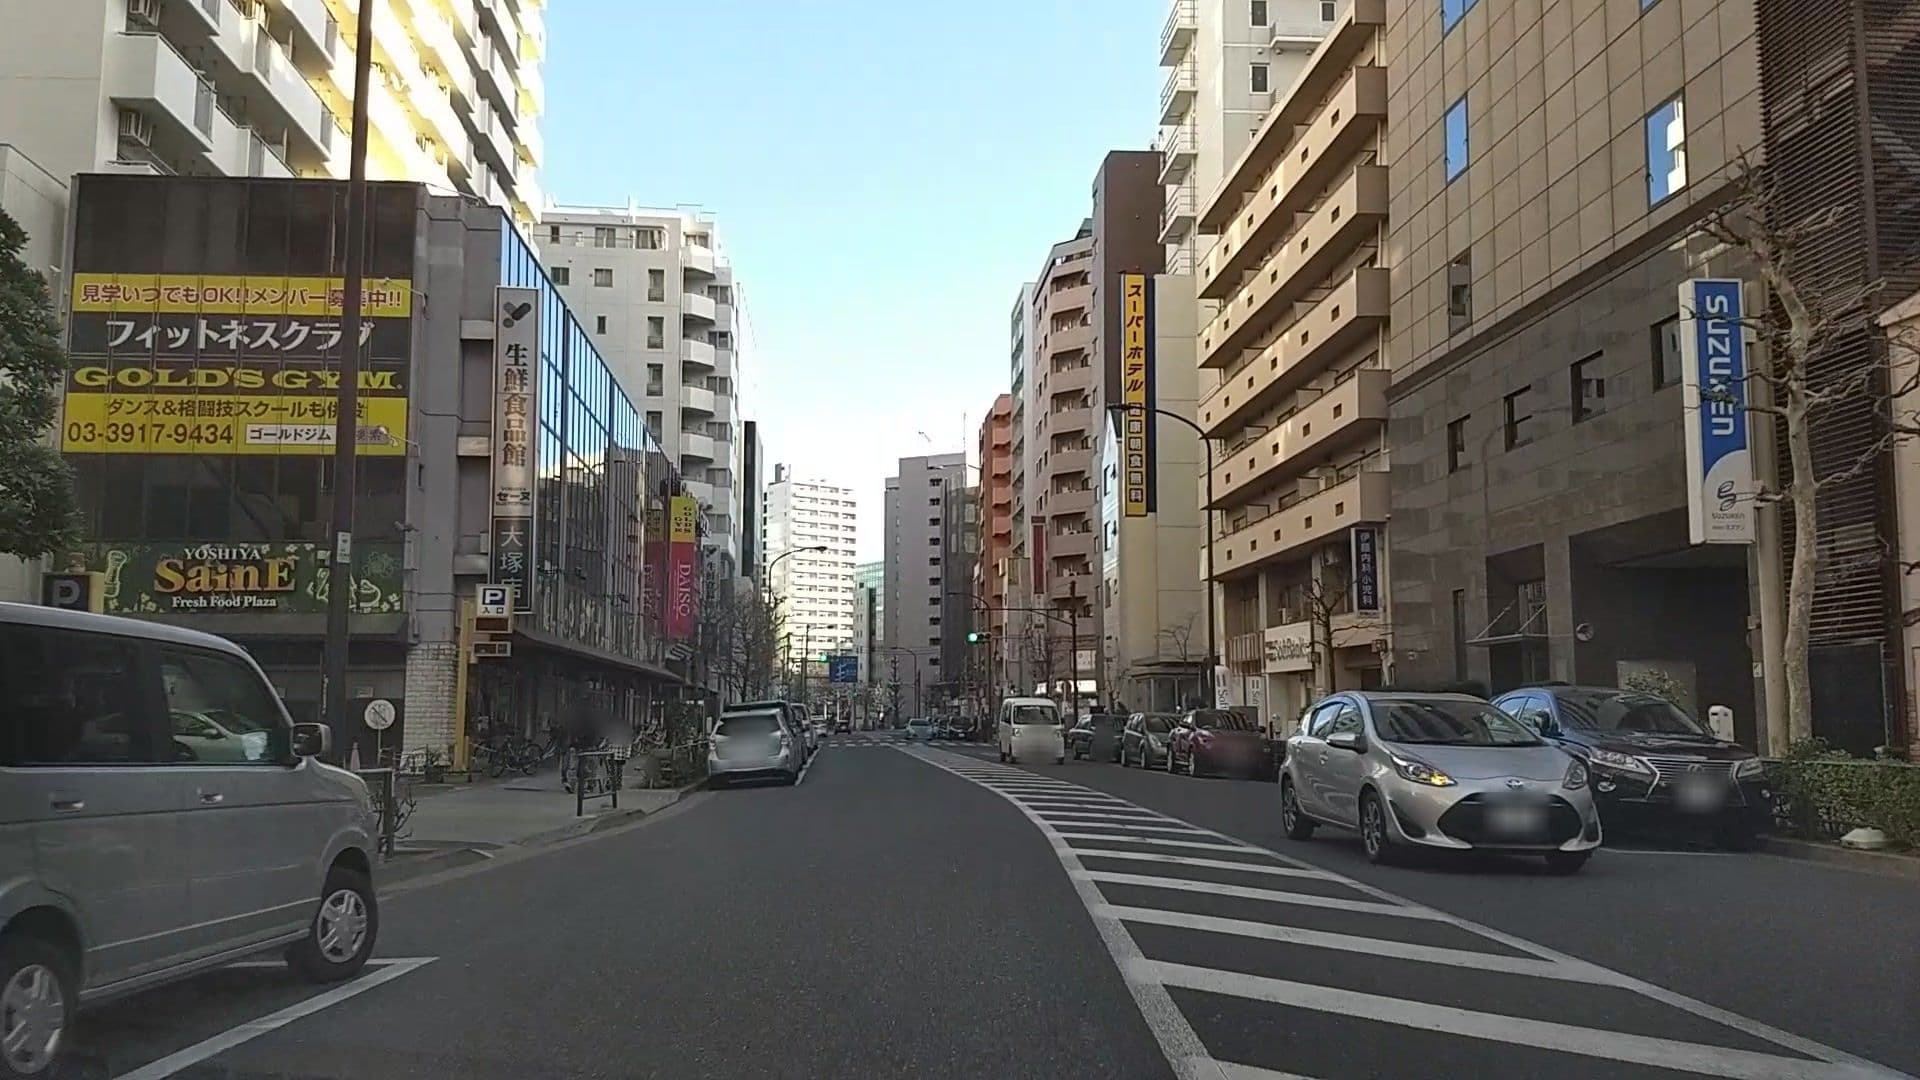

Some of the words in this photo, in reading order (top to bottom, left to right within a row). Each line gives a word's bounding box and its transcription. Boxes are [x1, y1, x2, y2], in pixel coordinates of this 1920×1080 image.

[1127, 283, 1144, 393] スーパーホテル
[1705, 294, 1735, 436] SUZUKEN
[74, 366, 265, 389] GOLD'S
[502, 343, 529, 467] 生鮮食品館
[67, 422, 233, 444] 03-3917-9434
[249, 427, 332, 441] ゴールドジム
[496, 490, 531, 501] セーヌ
[184, 548, 262, 560] YOSHIYA
[153, 558, 296, 592] SainE
[53, 580, 80, 606] P
[172, 596, 207, 608] Fresh
[210, 595, 240, 607] Food
[243, 596, 277, 607] Plaza
[485, 590, 503, 604] P
[679, 564, 691, 617] DAISO
